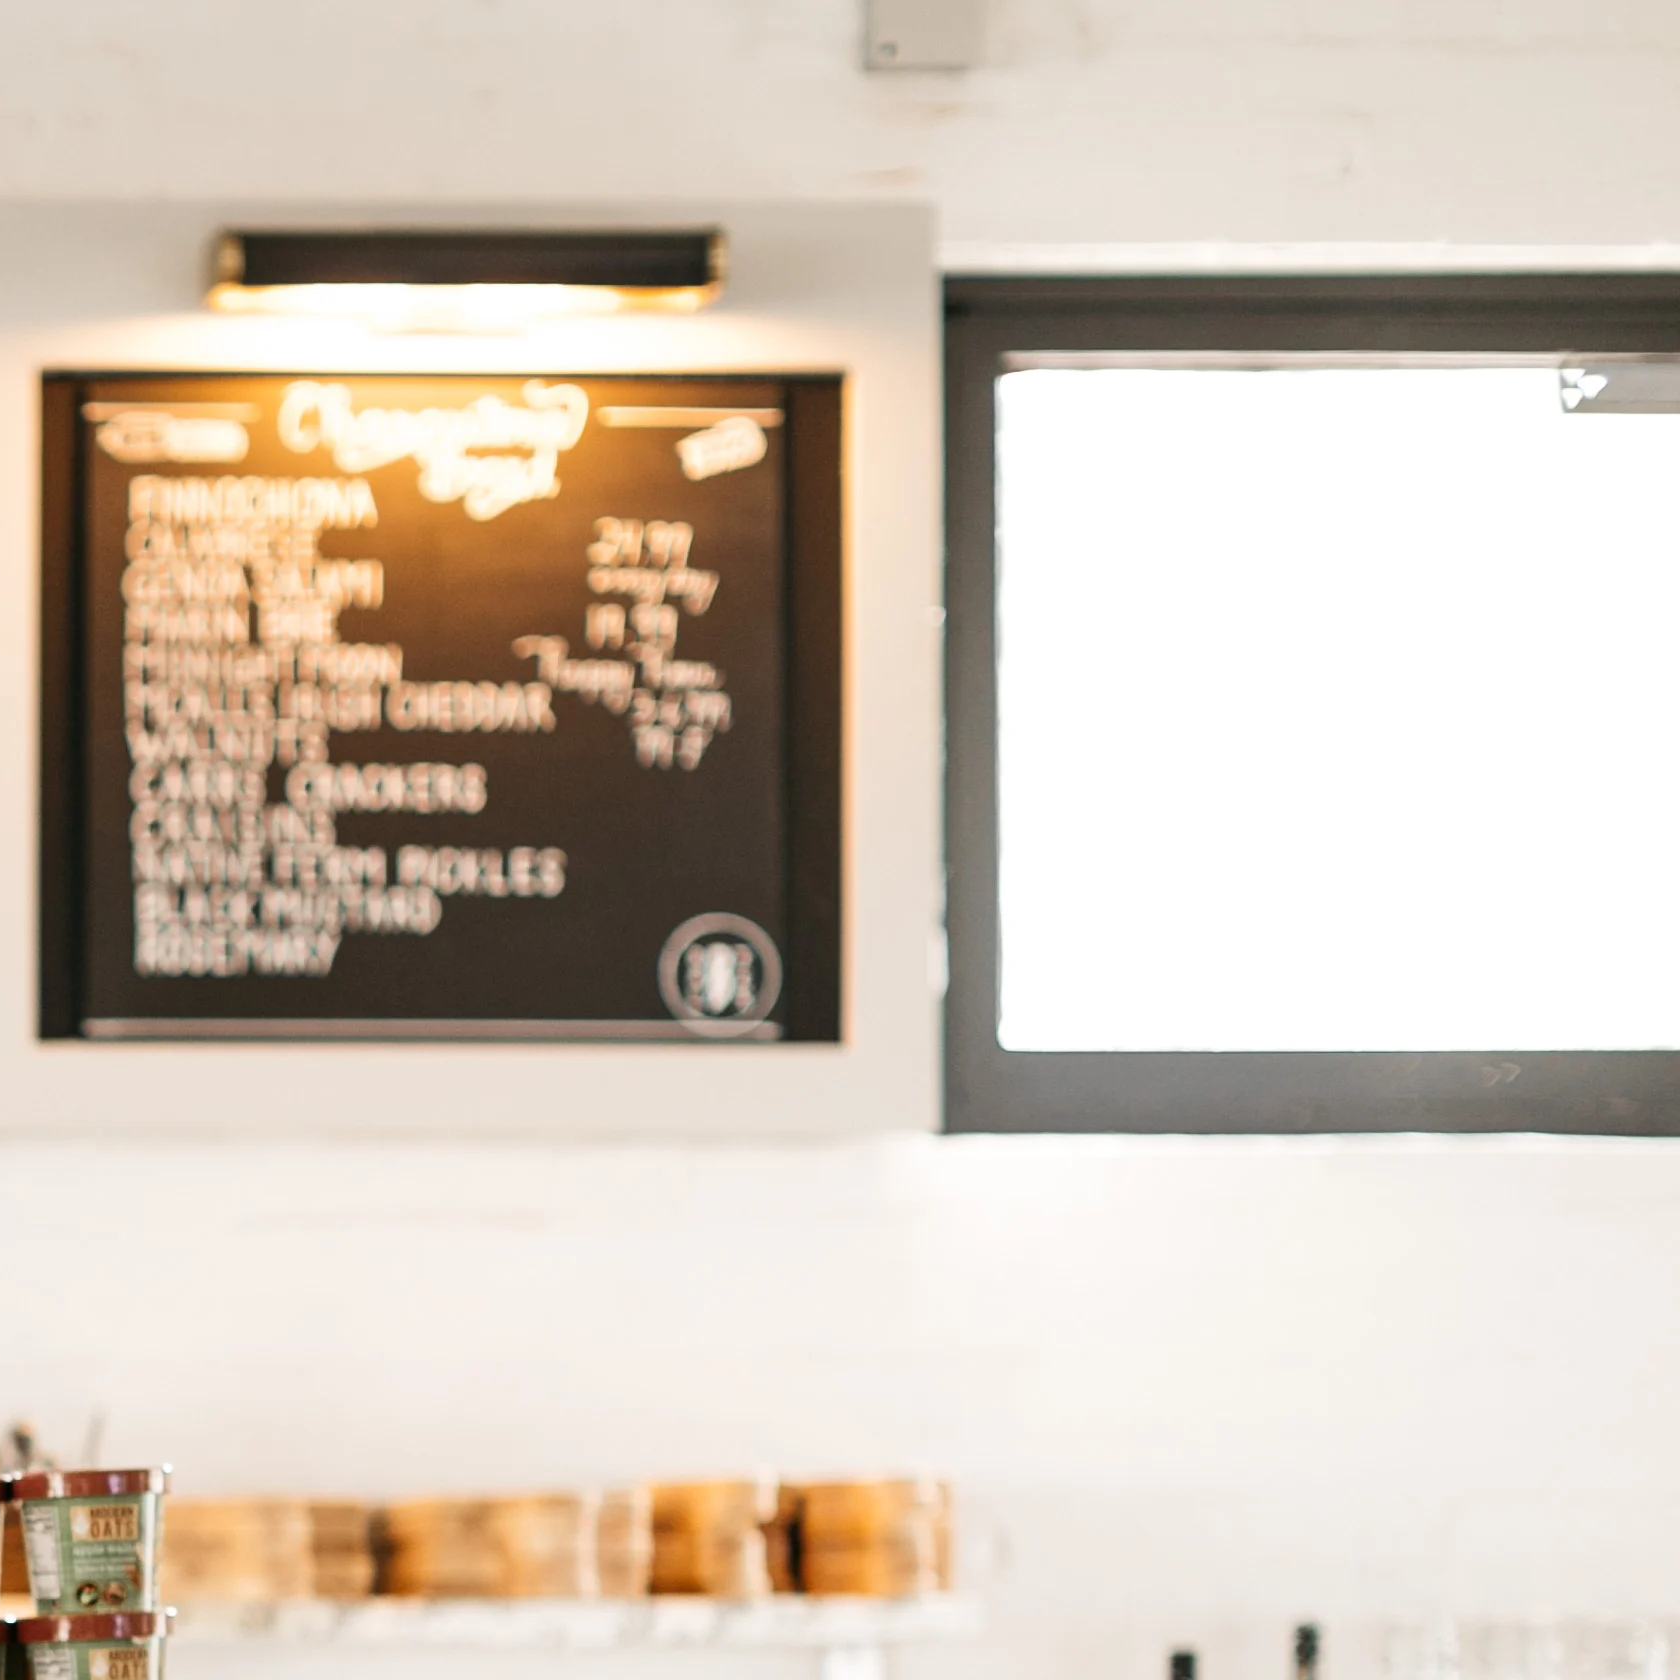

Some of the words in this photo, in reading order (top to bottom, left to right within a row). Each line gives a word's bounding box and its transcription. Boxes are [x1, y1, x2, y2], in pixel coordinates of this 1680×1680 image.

[90, 1506, 134, 1518] MODERN
[90, 1520, 134, 1539] OATS
[109, 1650, 148, 1662] MODERN
[109, 1664, 148, 1680] OATS
